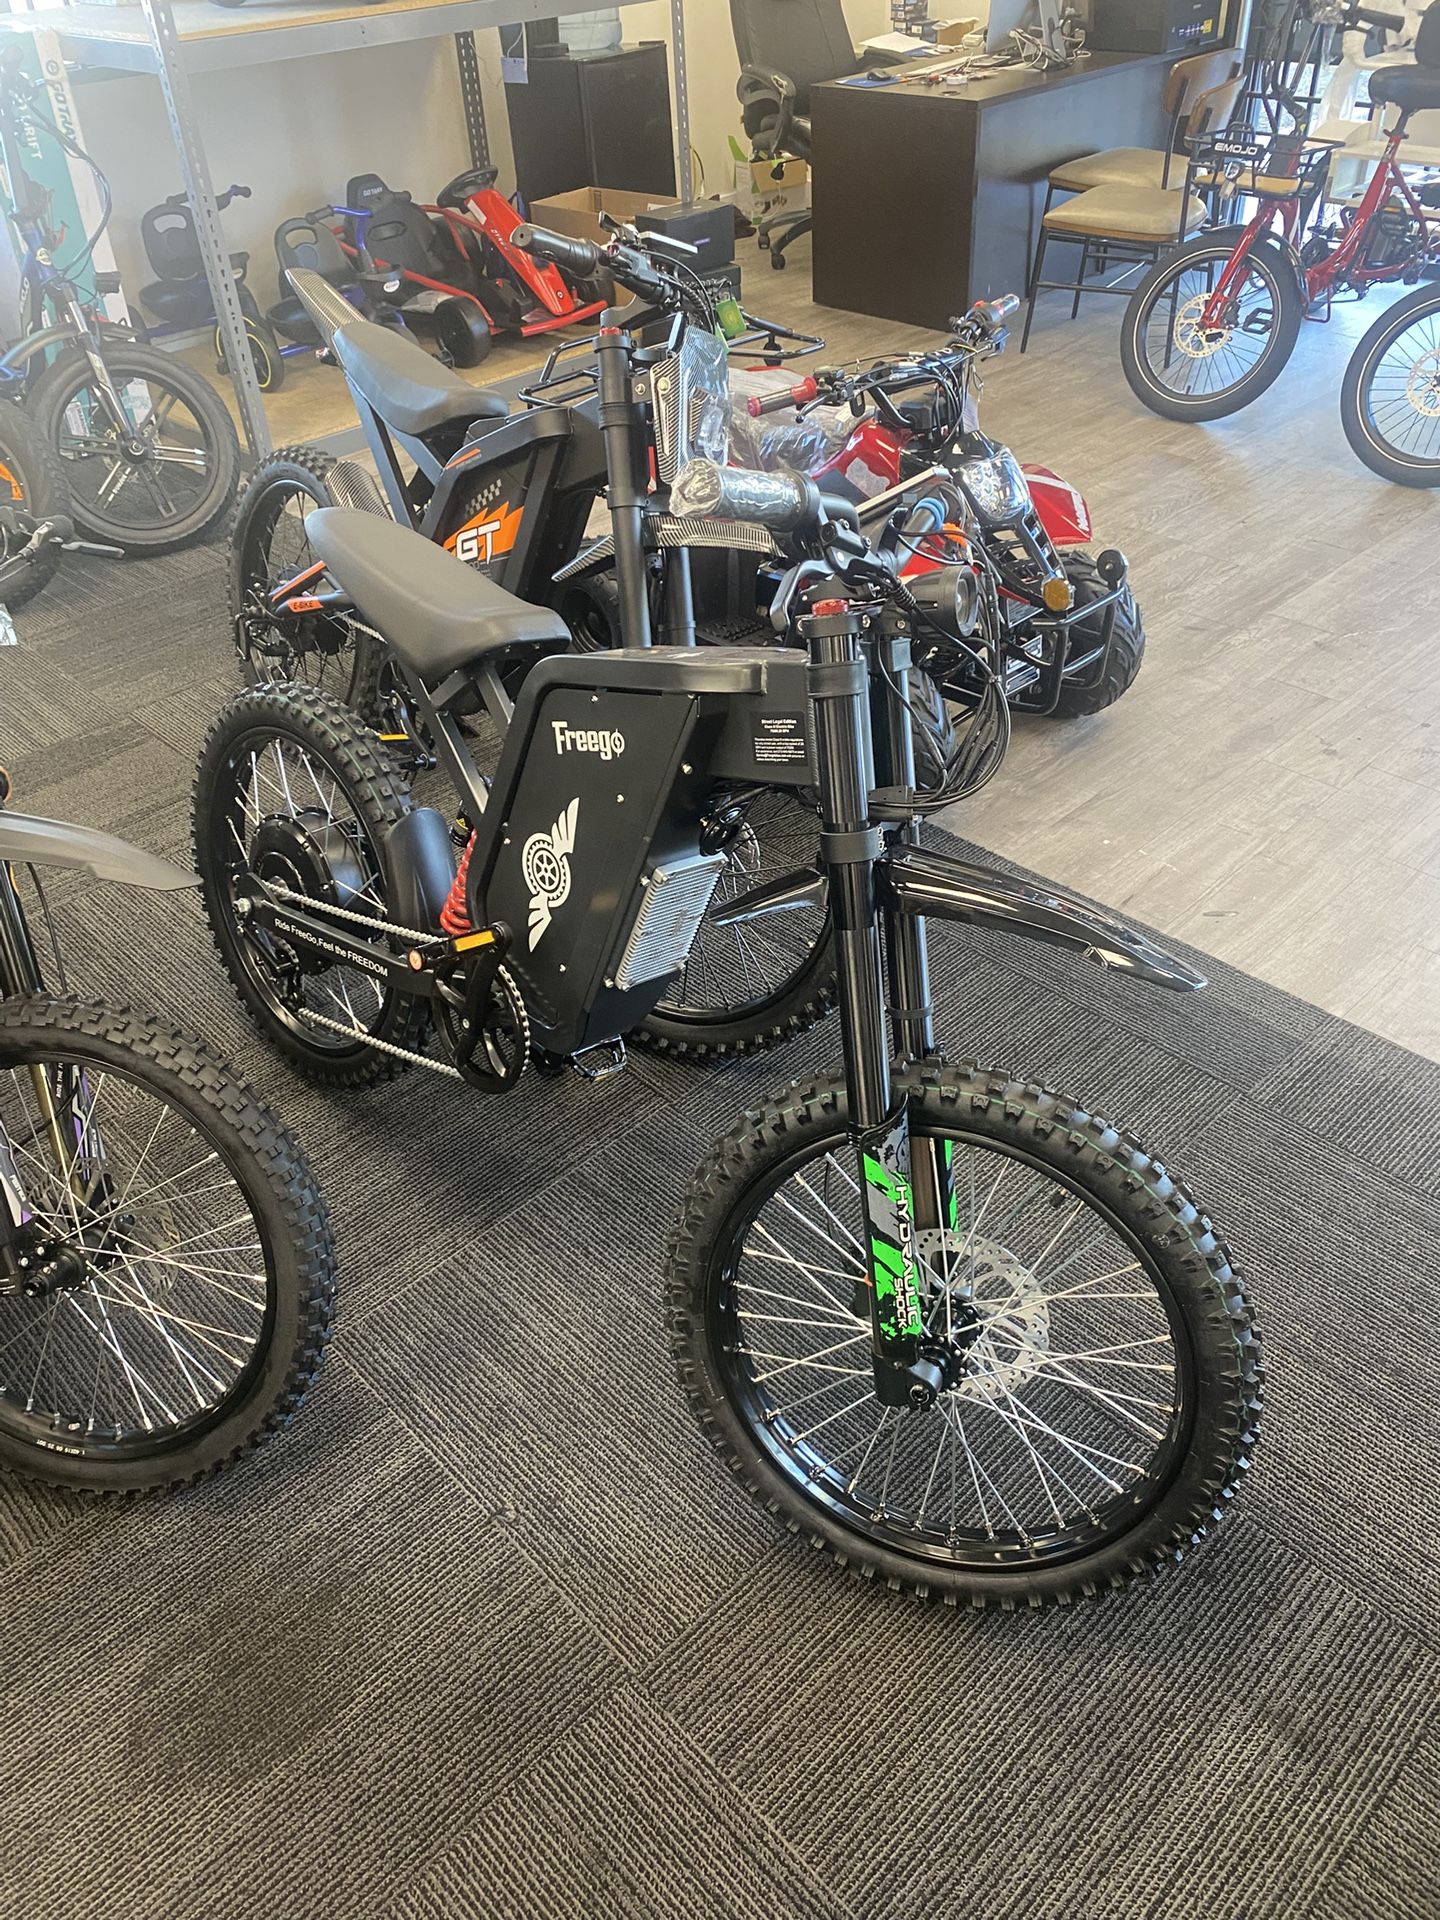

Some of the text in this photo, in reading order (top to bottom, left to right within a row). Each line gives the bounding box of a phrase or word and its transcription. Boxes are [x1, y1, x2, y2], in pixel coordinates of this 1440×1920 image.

[1214, 142, 1258, 156] EMOJO
[456, 520, 501, 565] GT
[551, 721, 625, 760] Freego
[274, 918, 291, 932] Ride
[335, 944, 347, 958] the
[347, 951, 388, 977] FREEDOM
[895, 1184, 919, 1327] HYDRAULIC
[893, 1277, 908, 1329] SHOCK
